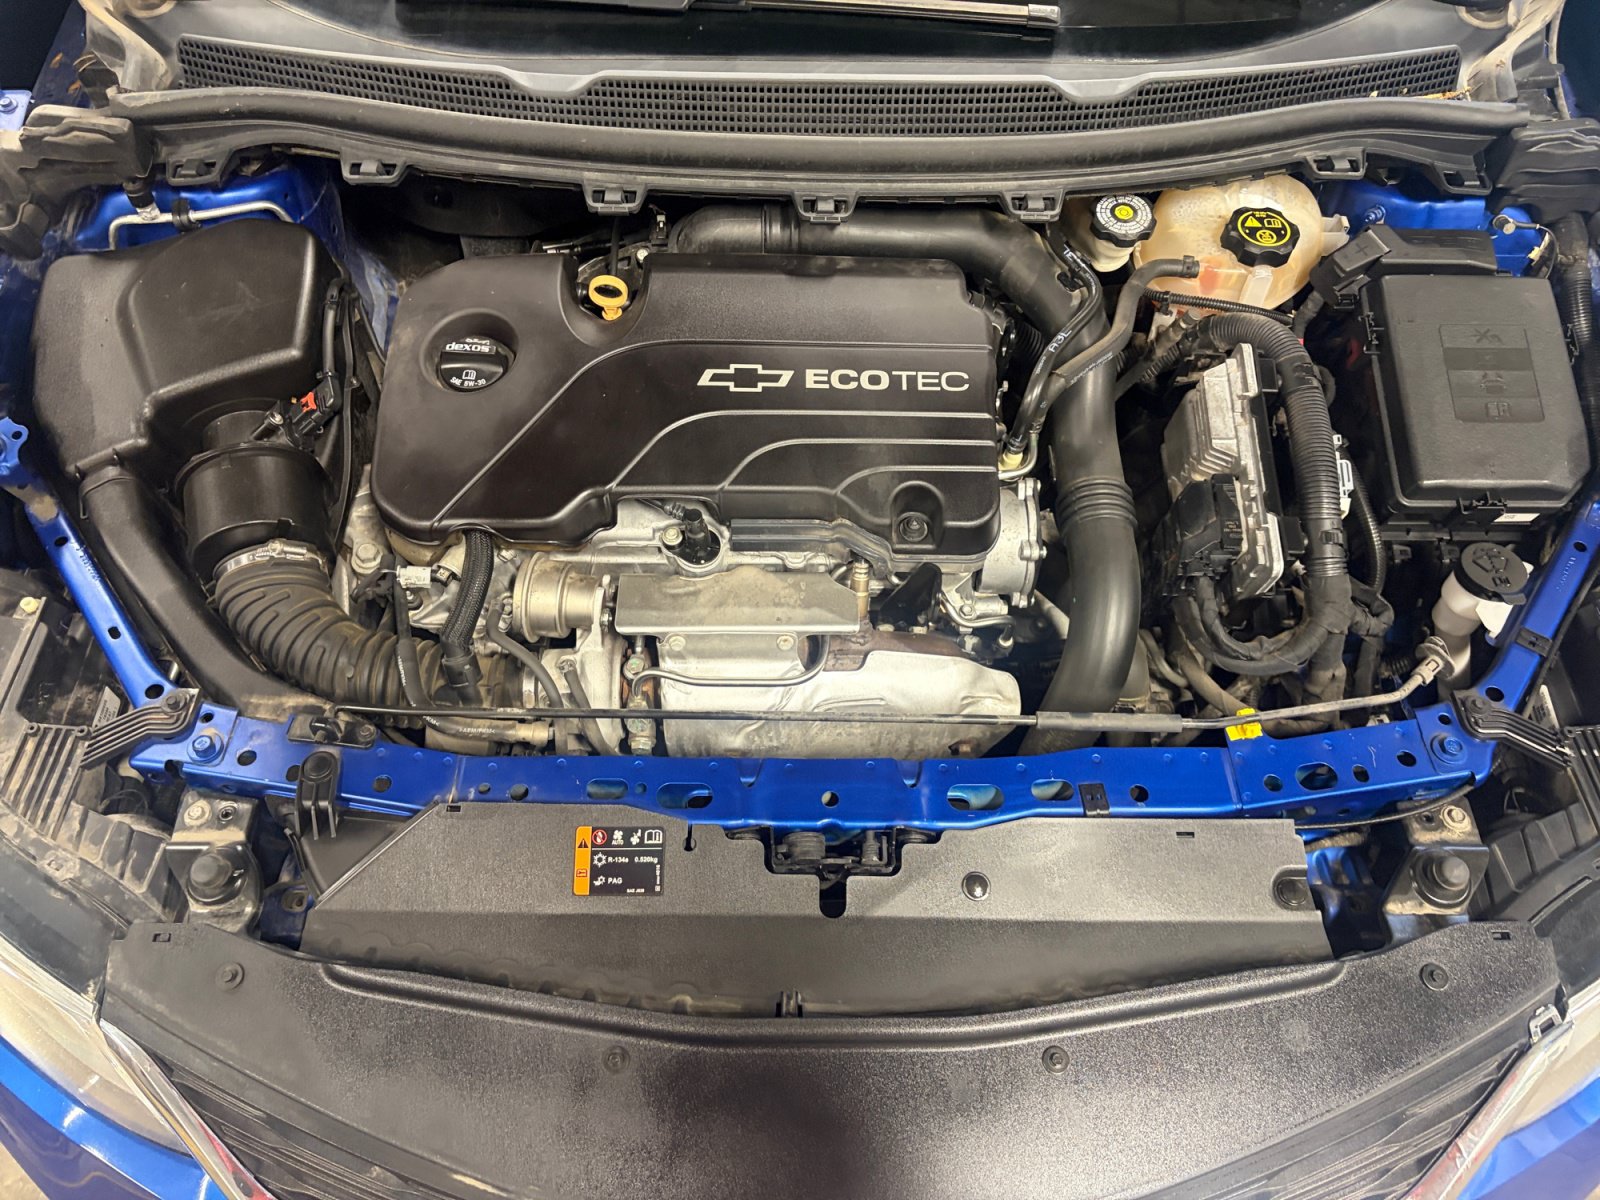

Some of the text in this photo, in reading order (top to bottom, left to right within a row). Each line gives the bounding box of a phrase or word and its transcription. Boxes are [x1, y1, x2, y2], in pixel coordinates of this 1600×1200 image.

[445, 342, 490, 353] dexos
[1048, 330, 1072, 353] A3L
[450, 376, 486, 387] SAE 5W-30
[805, 369, 970, 392] ECOTEC
